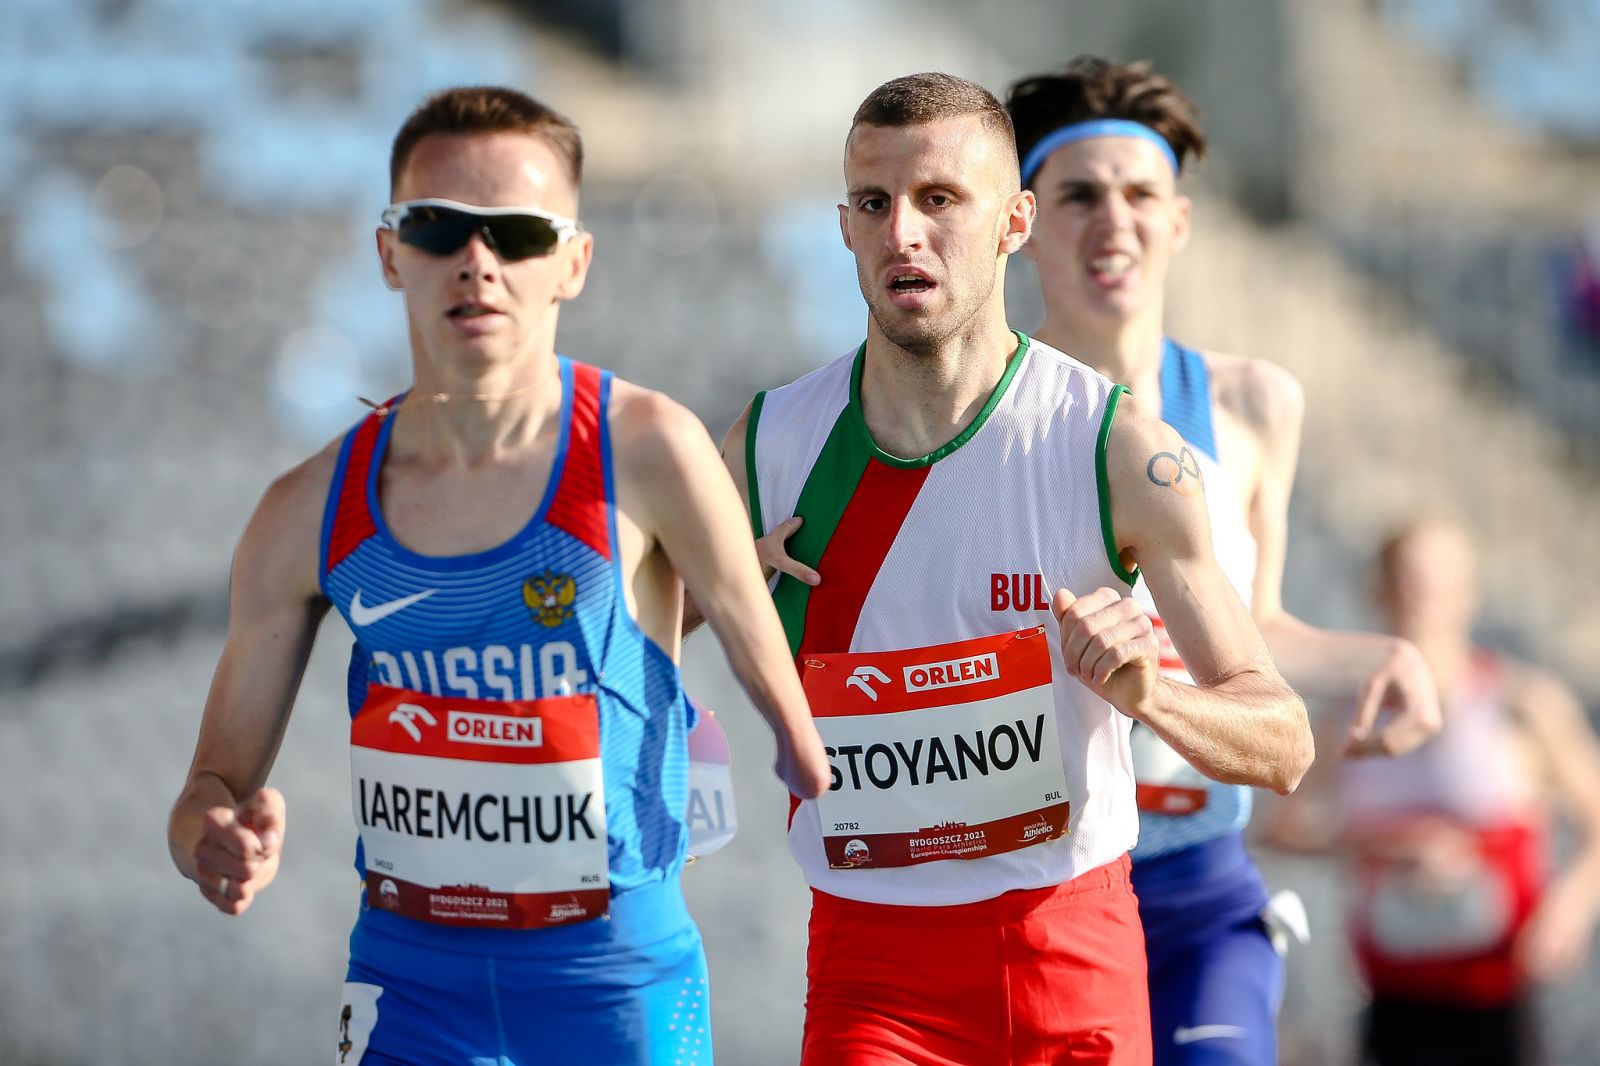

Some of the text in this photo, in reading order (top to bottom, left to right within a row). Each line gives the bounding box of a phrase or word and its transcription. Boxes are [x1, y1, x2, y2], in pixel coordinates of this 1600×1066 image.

[991, 573, 1049, 612] BUL
[371, 641, 588, 702] RUSSIA
[909, 657, 993, 688] ORLEN
[454, 717, 535, 741] ORLEN
[825, 713, 1046, 792] STOYANOV
[1044, 790, 1062, 802] BUL
[359, 778, 597, 844] IAREMCHUK
[833, 822, 860, 831] 20782
[909, 830, 986, 848] BYDGOSZCZ 2021
[910, 849, 940, 859] European
